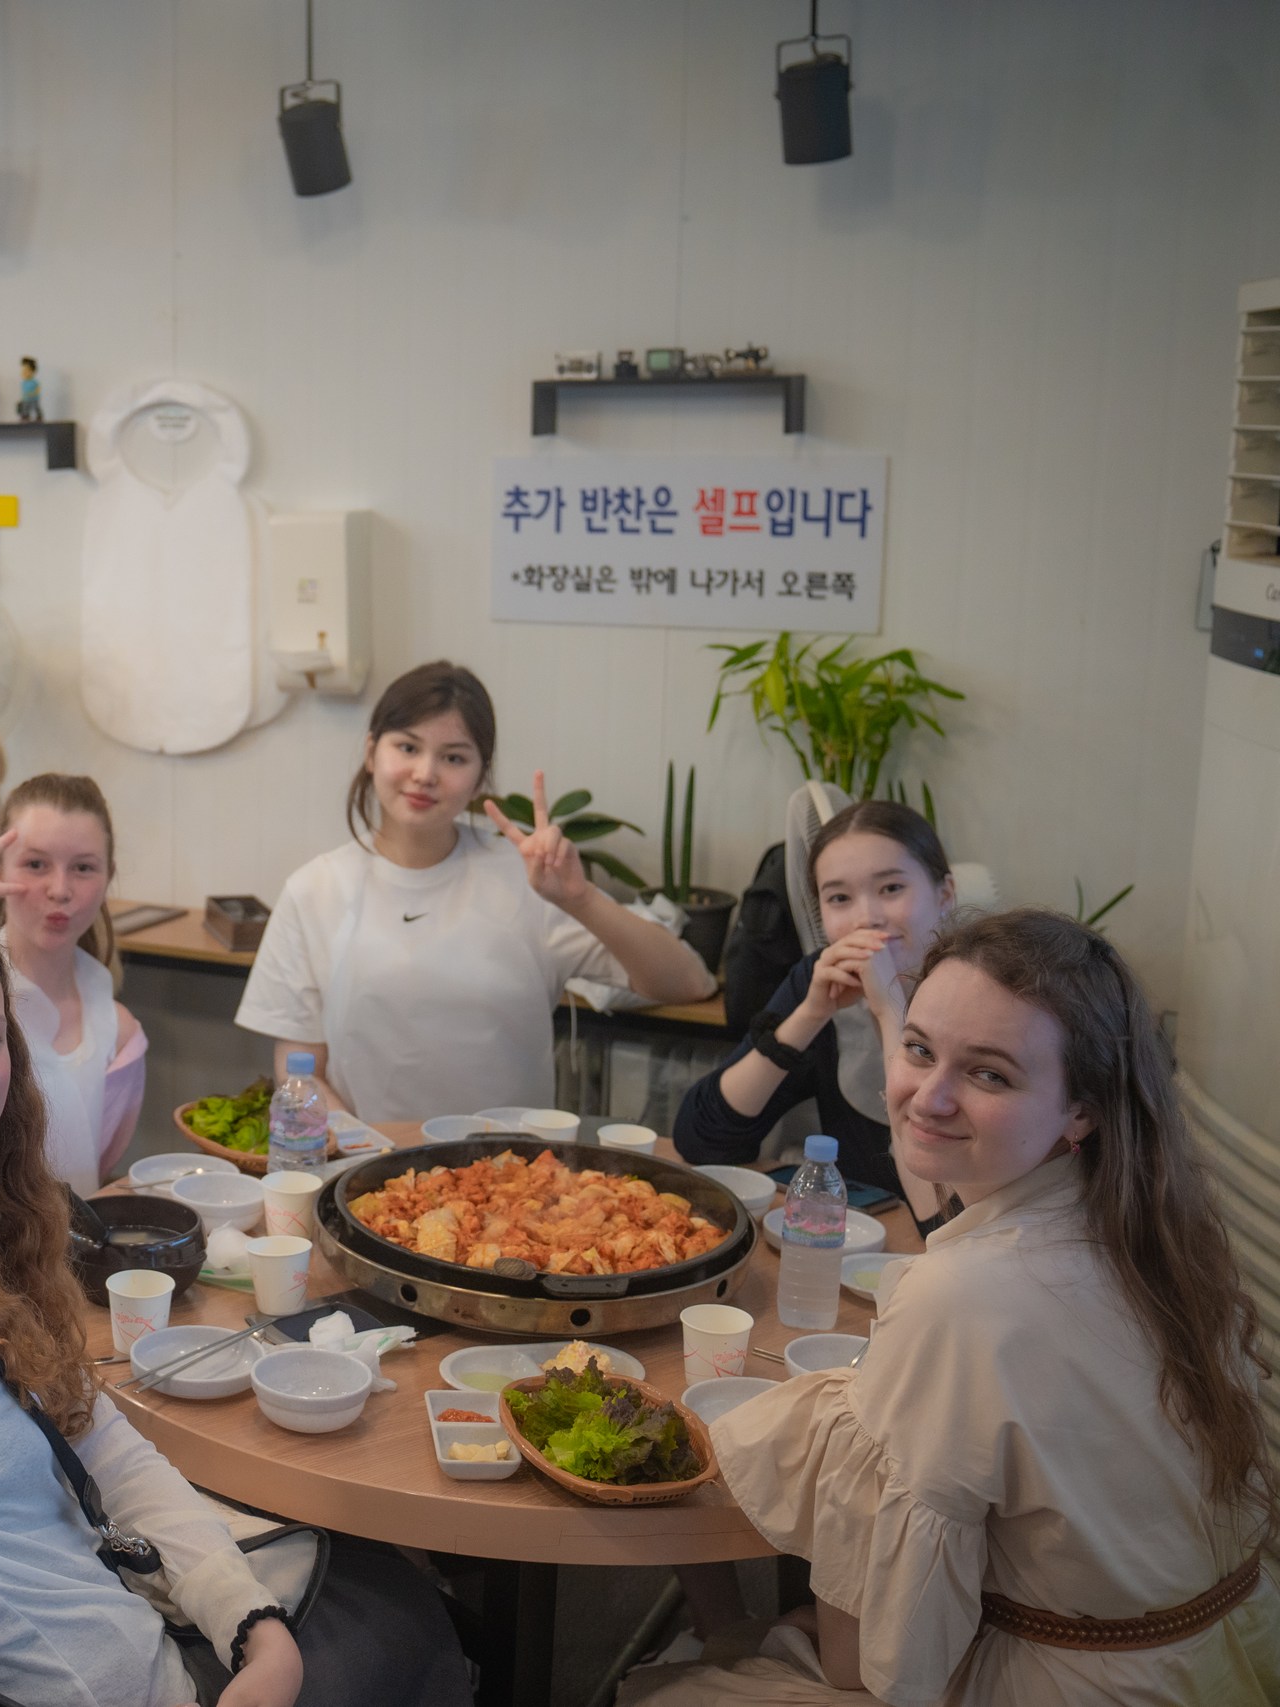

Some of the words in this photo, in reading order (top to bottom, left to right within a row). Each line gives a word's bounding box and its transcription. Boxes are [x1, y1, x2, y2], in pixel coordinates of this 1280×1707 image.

[501, 485, 567, 534] 추가
[579, 485, 679, 536] 반찬은
[693, 486, 873, 538] 셀프입니다
[629, 566, 678, 595] 밖에
[690, 567, 766, 598] 나가서
[776, 570, 858, 600] 오른쪽
